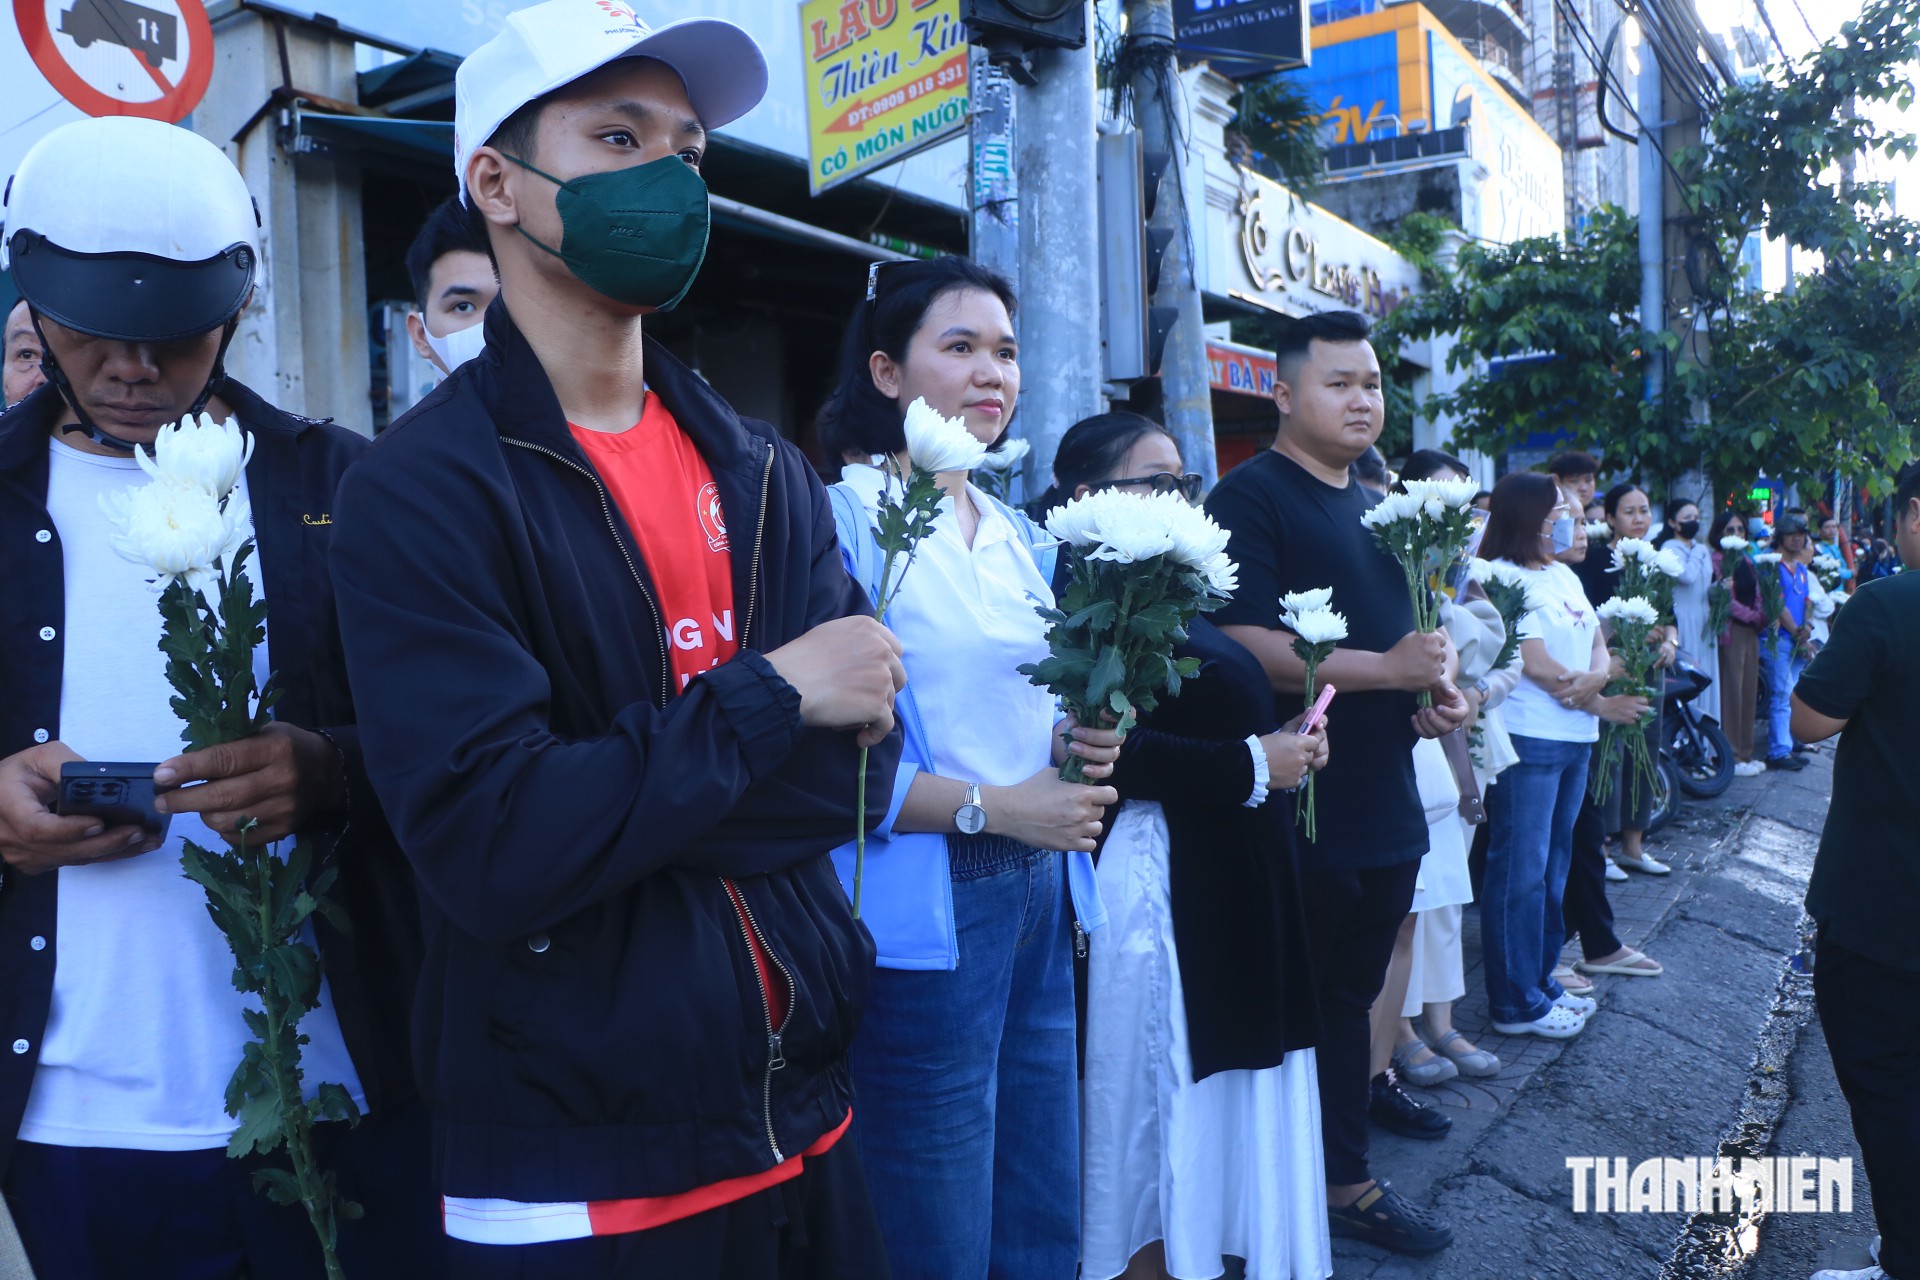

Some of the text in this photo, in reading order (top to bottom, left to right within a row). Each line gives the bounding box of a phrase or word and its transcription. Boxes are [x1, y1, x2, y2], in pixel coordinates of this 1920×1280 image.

[820, 48, 899, 108] Thiên
[908, 76, 934, 99] 918
[937, 63, 963, 87] 331
[820, 145, 848, 176] CÓ
[855, 125, 904, 162] MÓN
